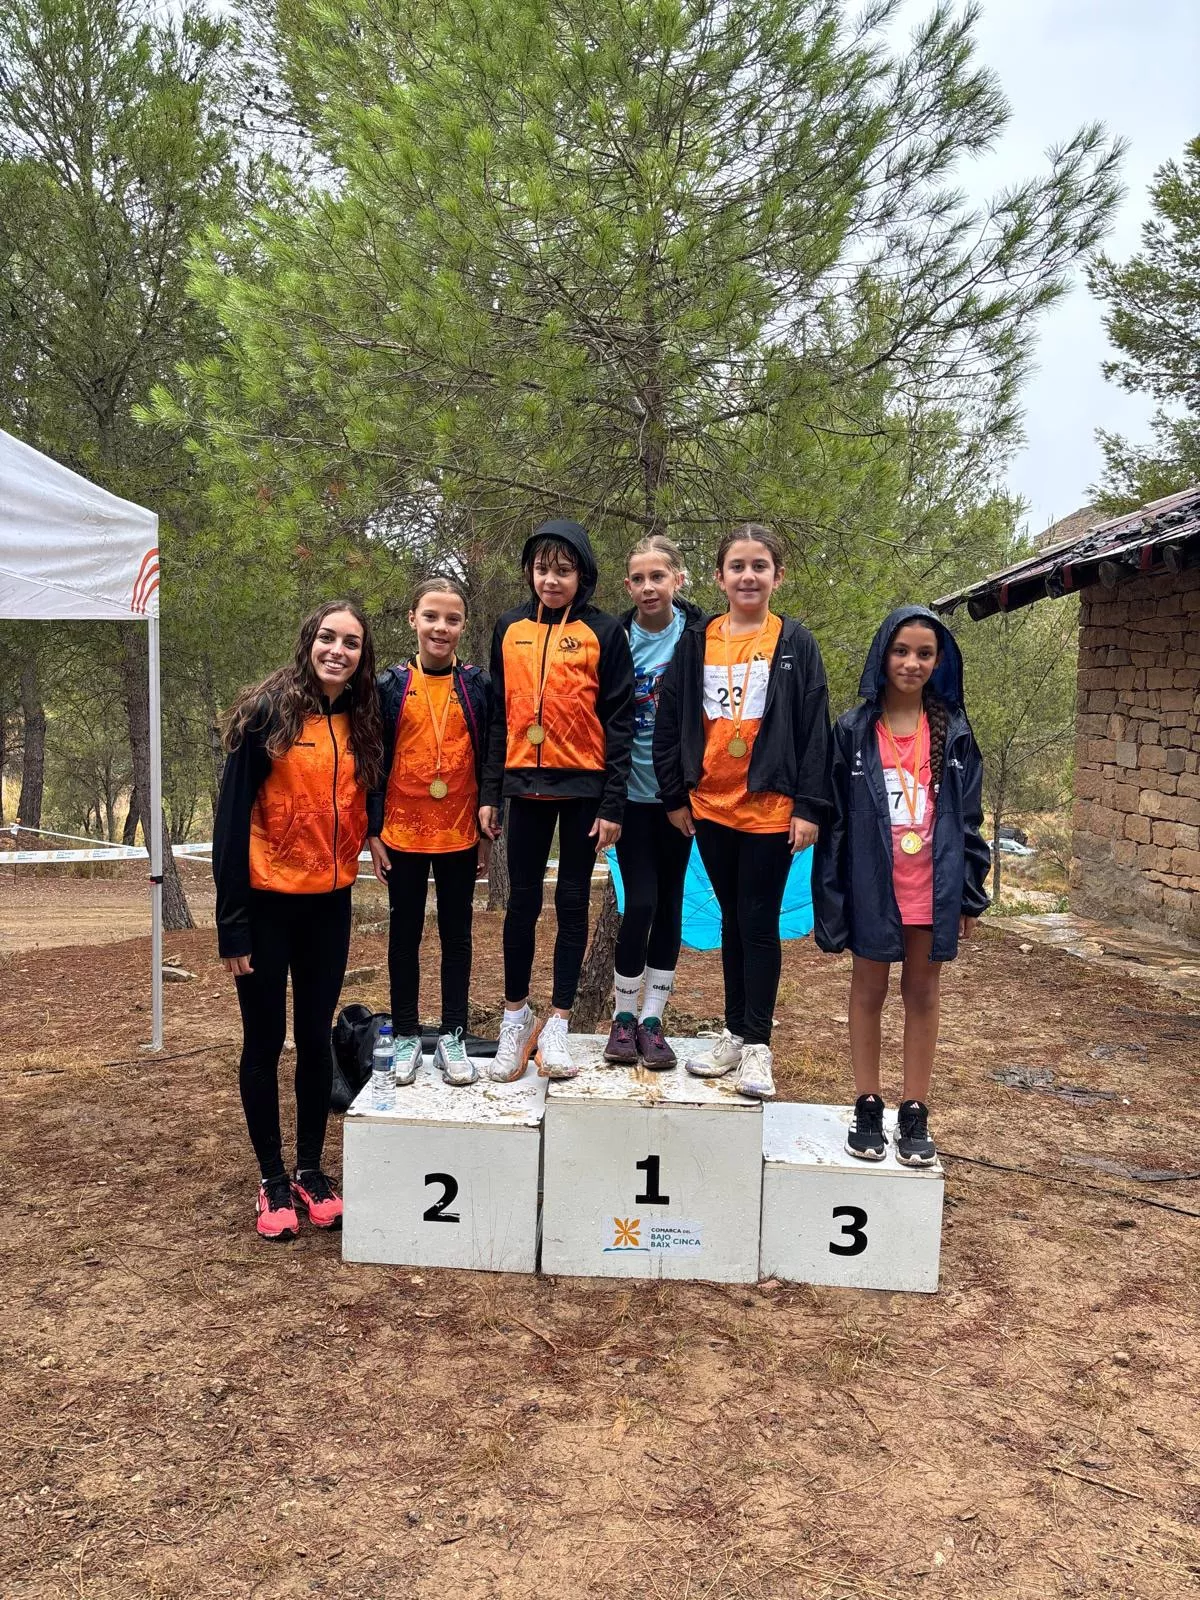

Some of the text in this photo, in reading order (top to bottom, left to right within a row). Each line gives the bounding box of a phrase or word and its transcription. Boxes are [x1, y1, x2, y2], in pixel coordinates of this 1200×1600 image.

[717, 686, 743, 708] 23
[888, 791, 904, 810] 7
[652, 984, 672, 993] adid
[634, 1155, 670, 1205] 1
[422, 1172, 461, 1223] 2
[673, 1238, 701, 1246] CINCA
[828, 1206, 868, 1256] 3
